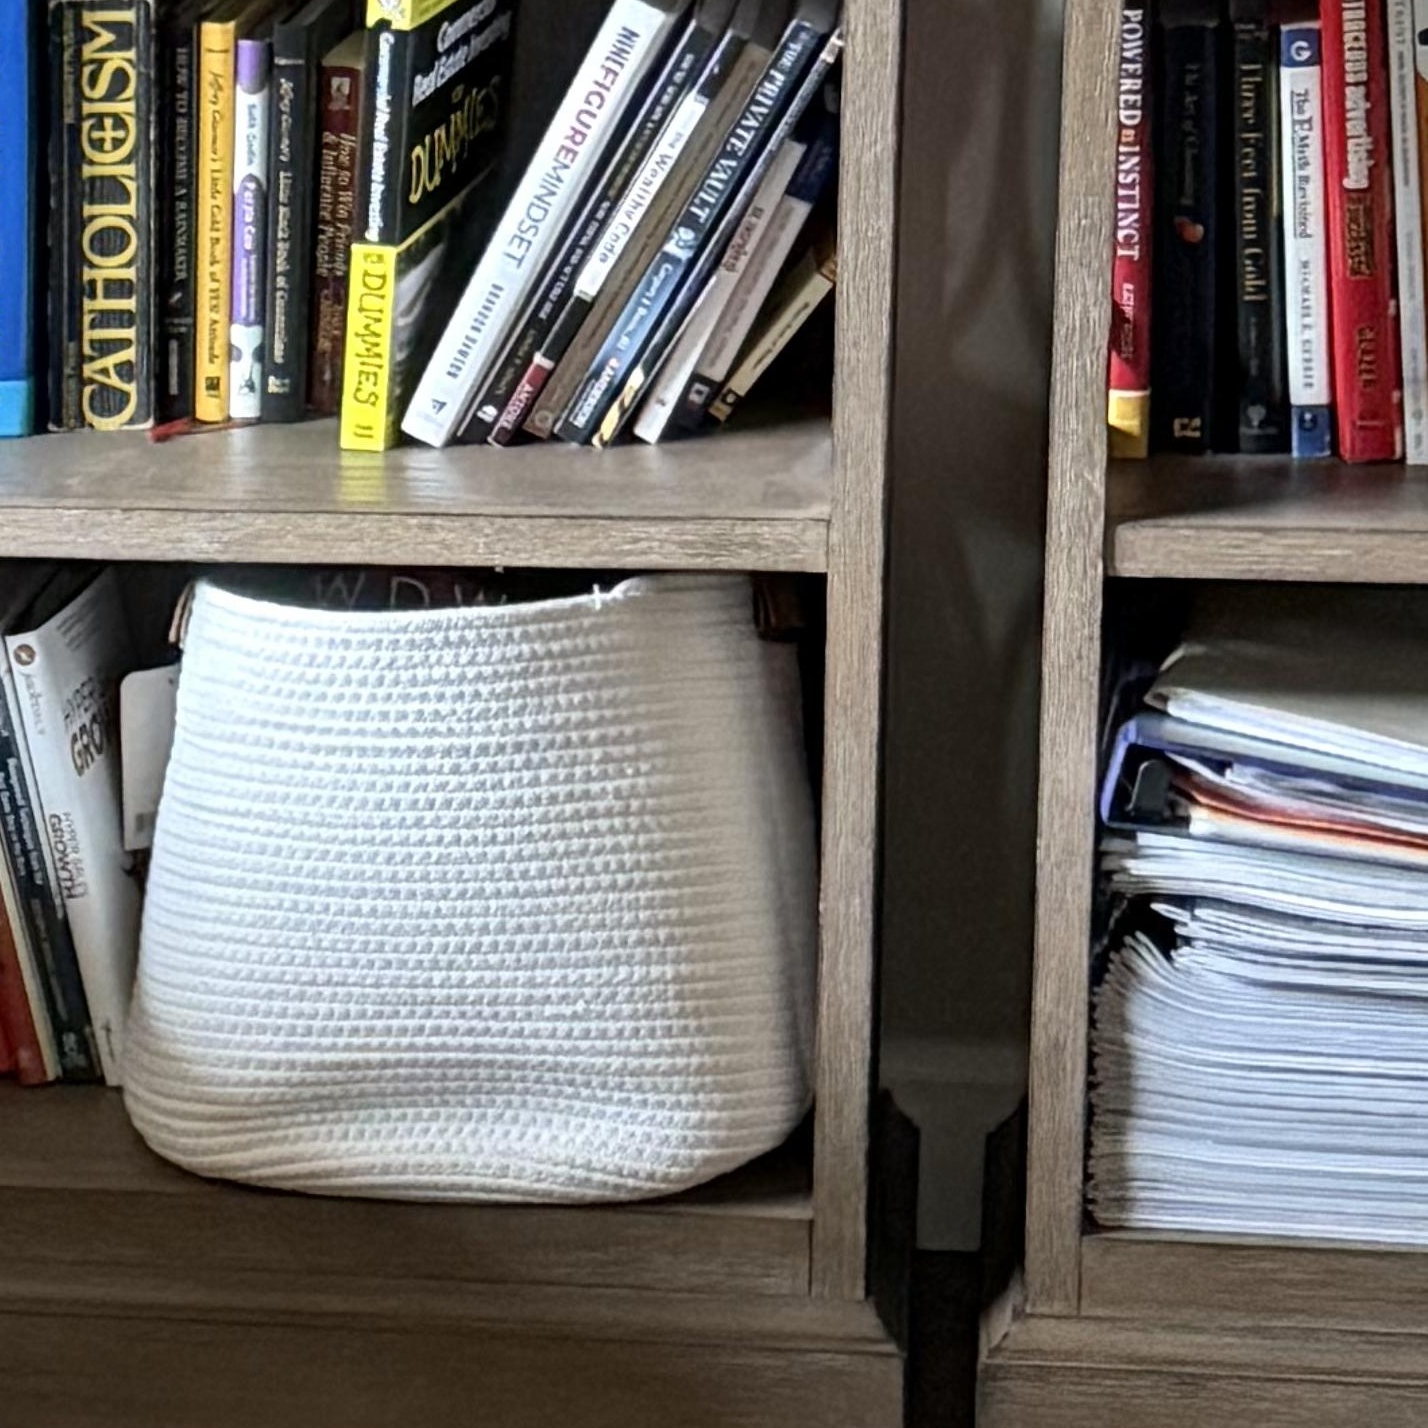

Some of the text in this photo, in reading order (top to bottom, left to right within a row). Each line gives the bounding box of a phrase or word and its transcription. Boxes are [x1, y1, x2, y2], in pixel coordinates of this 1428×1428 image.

[720, 69, 793, 156] PRIVATE
[1115, 8, 1145, 261] POWERED INSTINCT
[1343, 86, 1373, 190] advertising
[80, 9, 138, 428] CATHOLICISM
[315, 147, 338, 276] Influence People
[331, 131, 357, 276] How to Win Friends
[625, 153, 677, 222] Wealthy
[688, 156, 740, 222] VAULT
[1242, 187, 1268, 302] from Gold
[353, 269, 387, 407] DUMMIES
[48, 813, 77, 900] GROWTH
